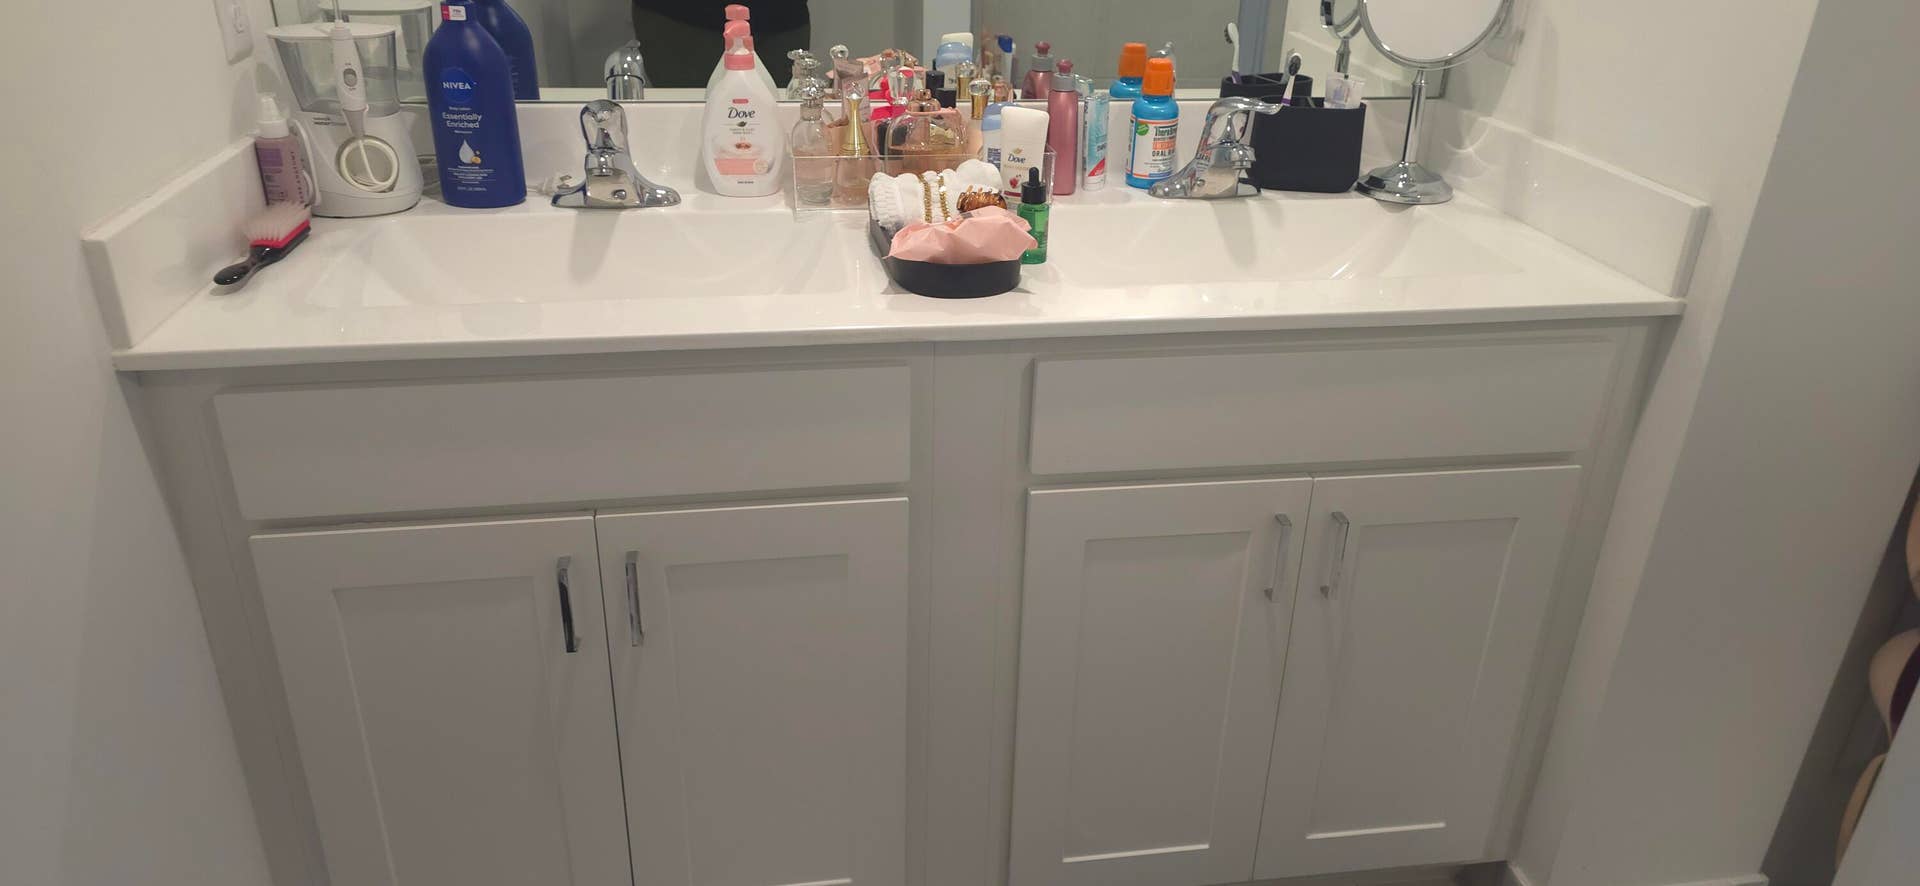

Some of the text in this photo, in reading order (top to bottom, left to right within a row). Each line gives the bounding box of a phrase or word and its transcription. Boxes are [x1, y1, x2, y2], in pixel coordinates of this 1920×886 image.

[442, 81, 472, 90] NIVEA
[441, 112, 482, 122] Essentially
[727, 106, 756, 119] Dove
[446, 120, 480, 129] Enriched
[1007, 153, 1026, 163] Dove
